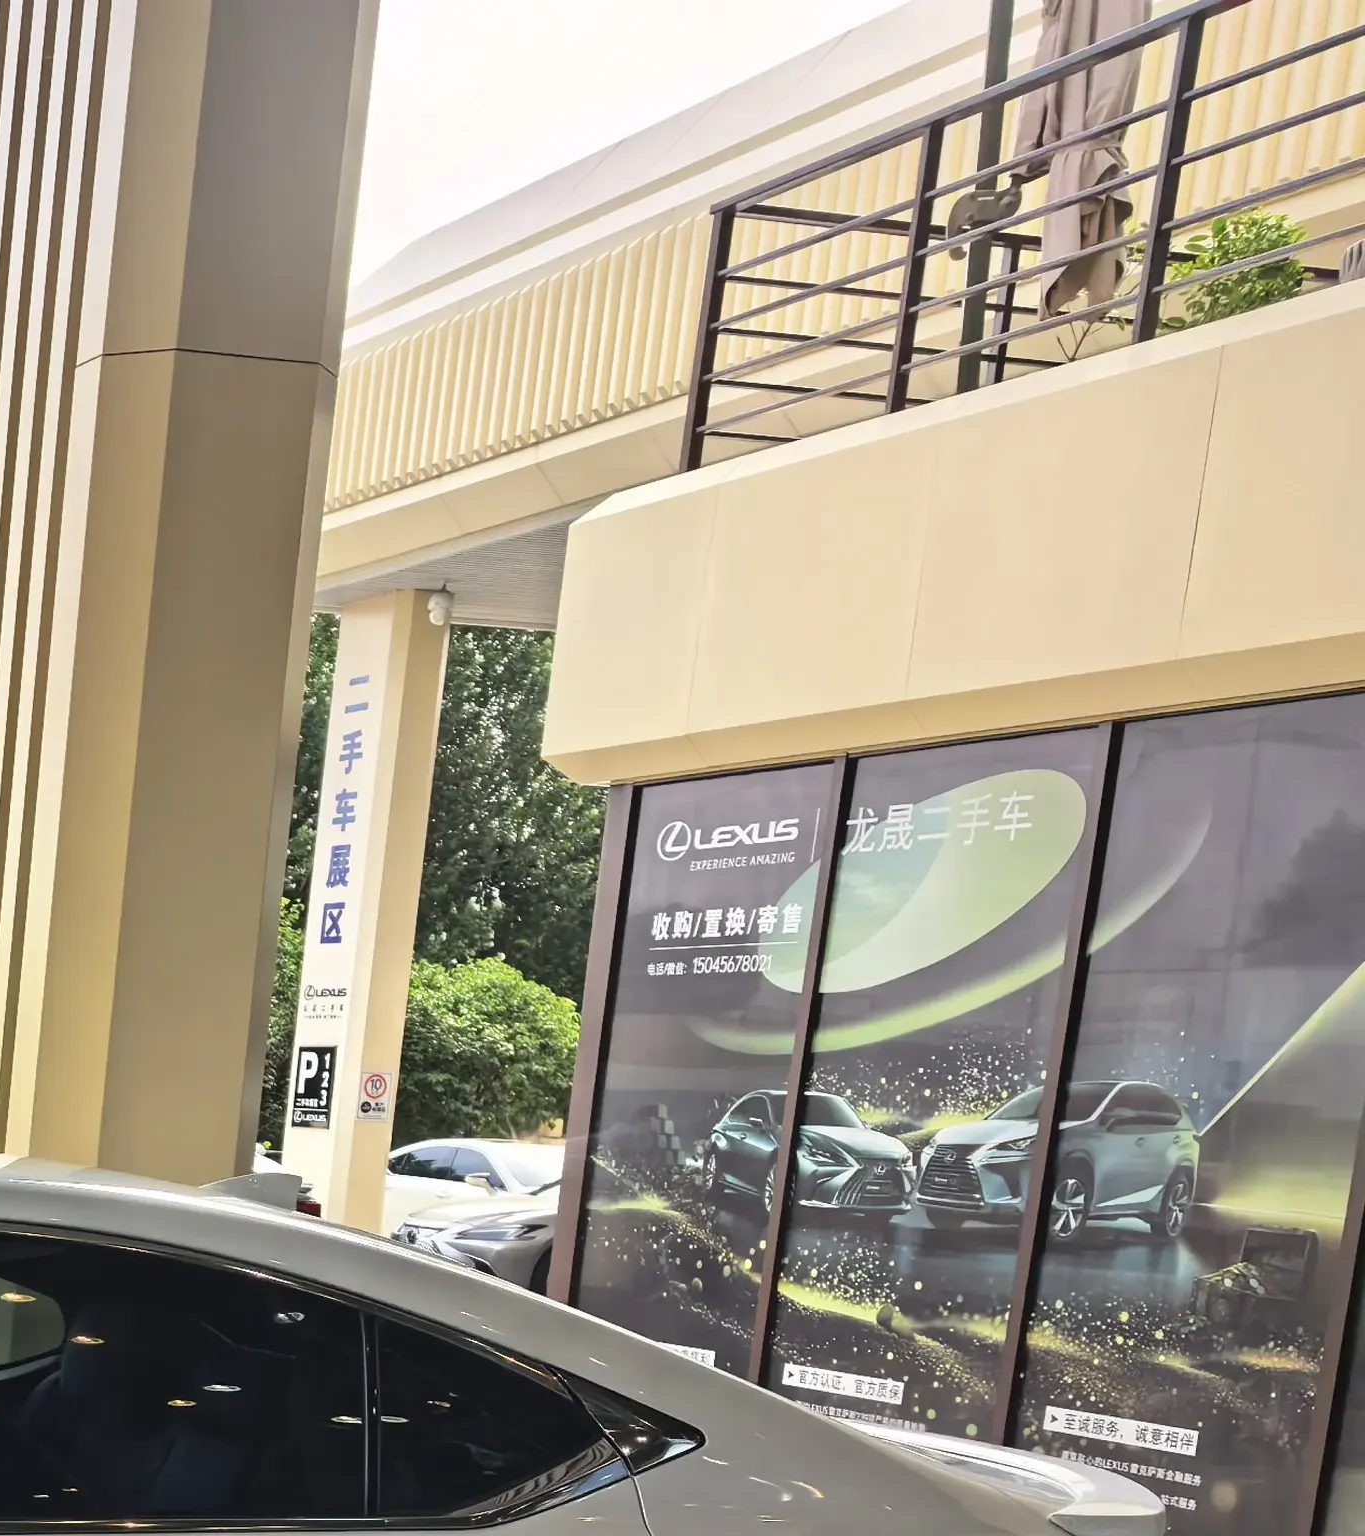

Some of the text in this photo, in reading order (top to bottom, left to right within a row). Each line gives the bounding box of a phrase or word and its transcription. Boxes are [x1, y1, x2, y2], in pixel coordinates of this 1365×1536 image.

[320, 674, 369, 944] 二手车展区
[841, 790, 1035, 856] 龙晟二手车
[694, 818, 800, 850] LEXUS
[689, 852, 796, 871] EXPERIENCE AMAZING
[651, 903, 803, 941] 收购/置换/寄售
[693, 954, 773, 974] 15045678021
[315, 988, 347, 997] LEXUS
[324, 1052, 331, 1070] 1
[297, 1051, 319, 1094] P
[321, 1071, 330, 1088] 2
[319, 1089, 328, 1107] 3
